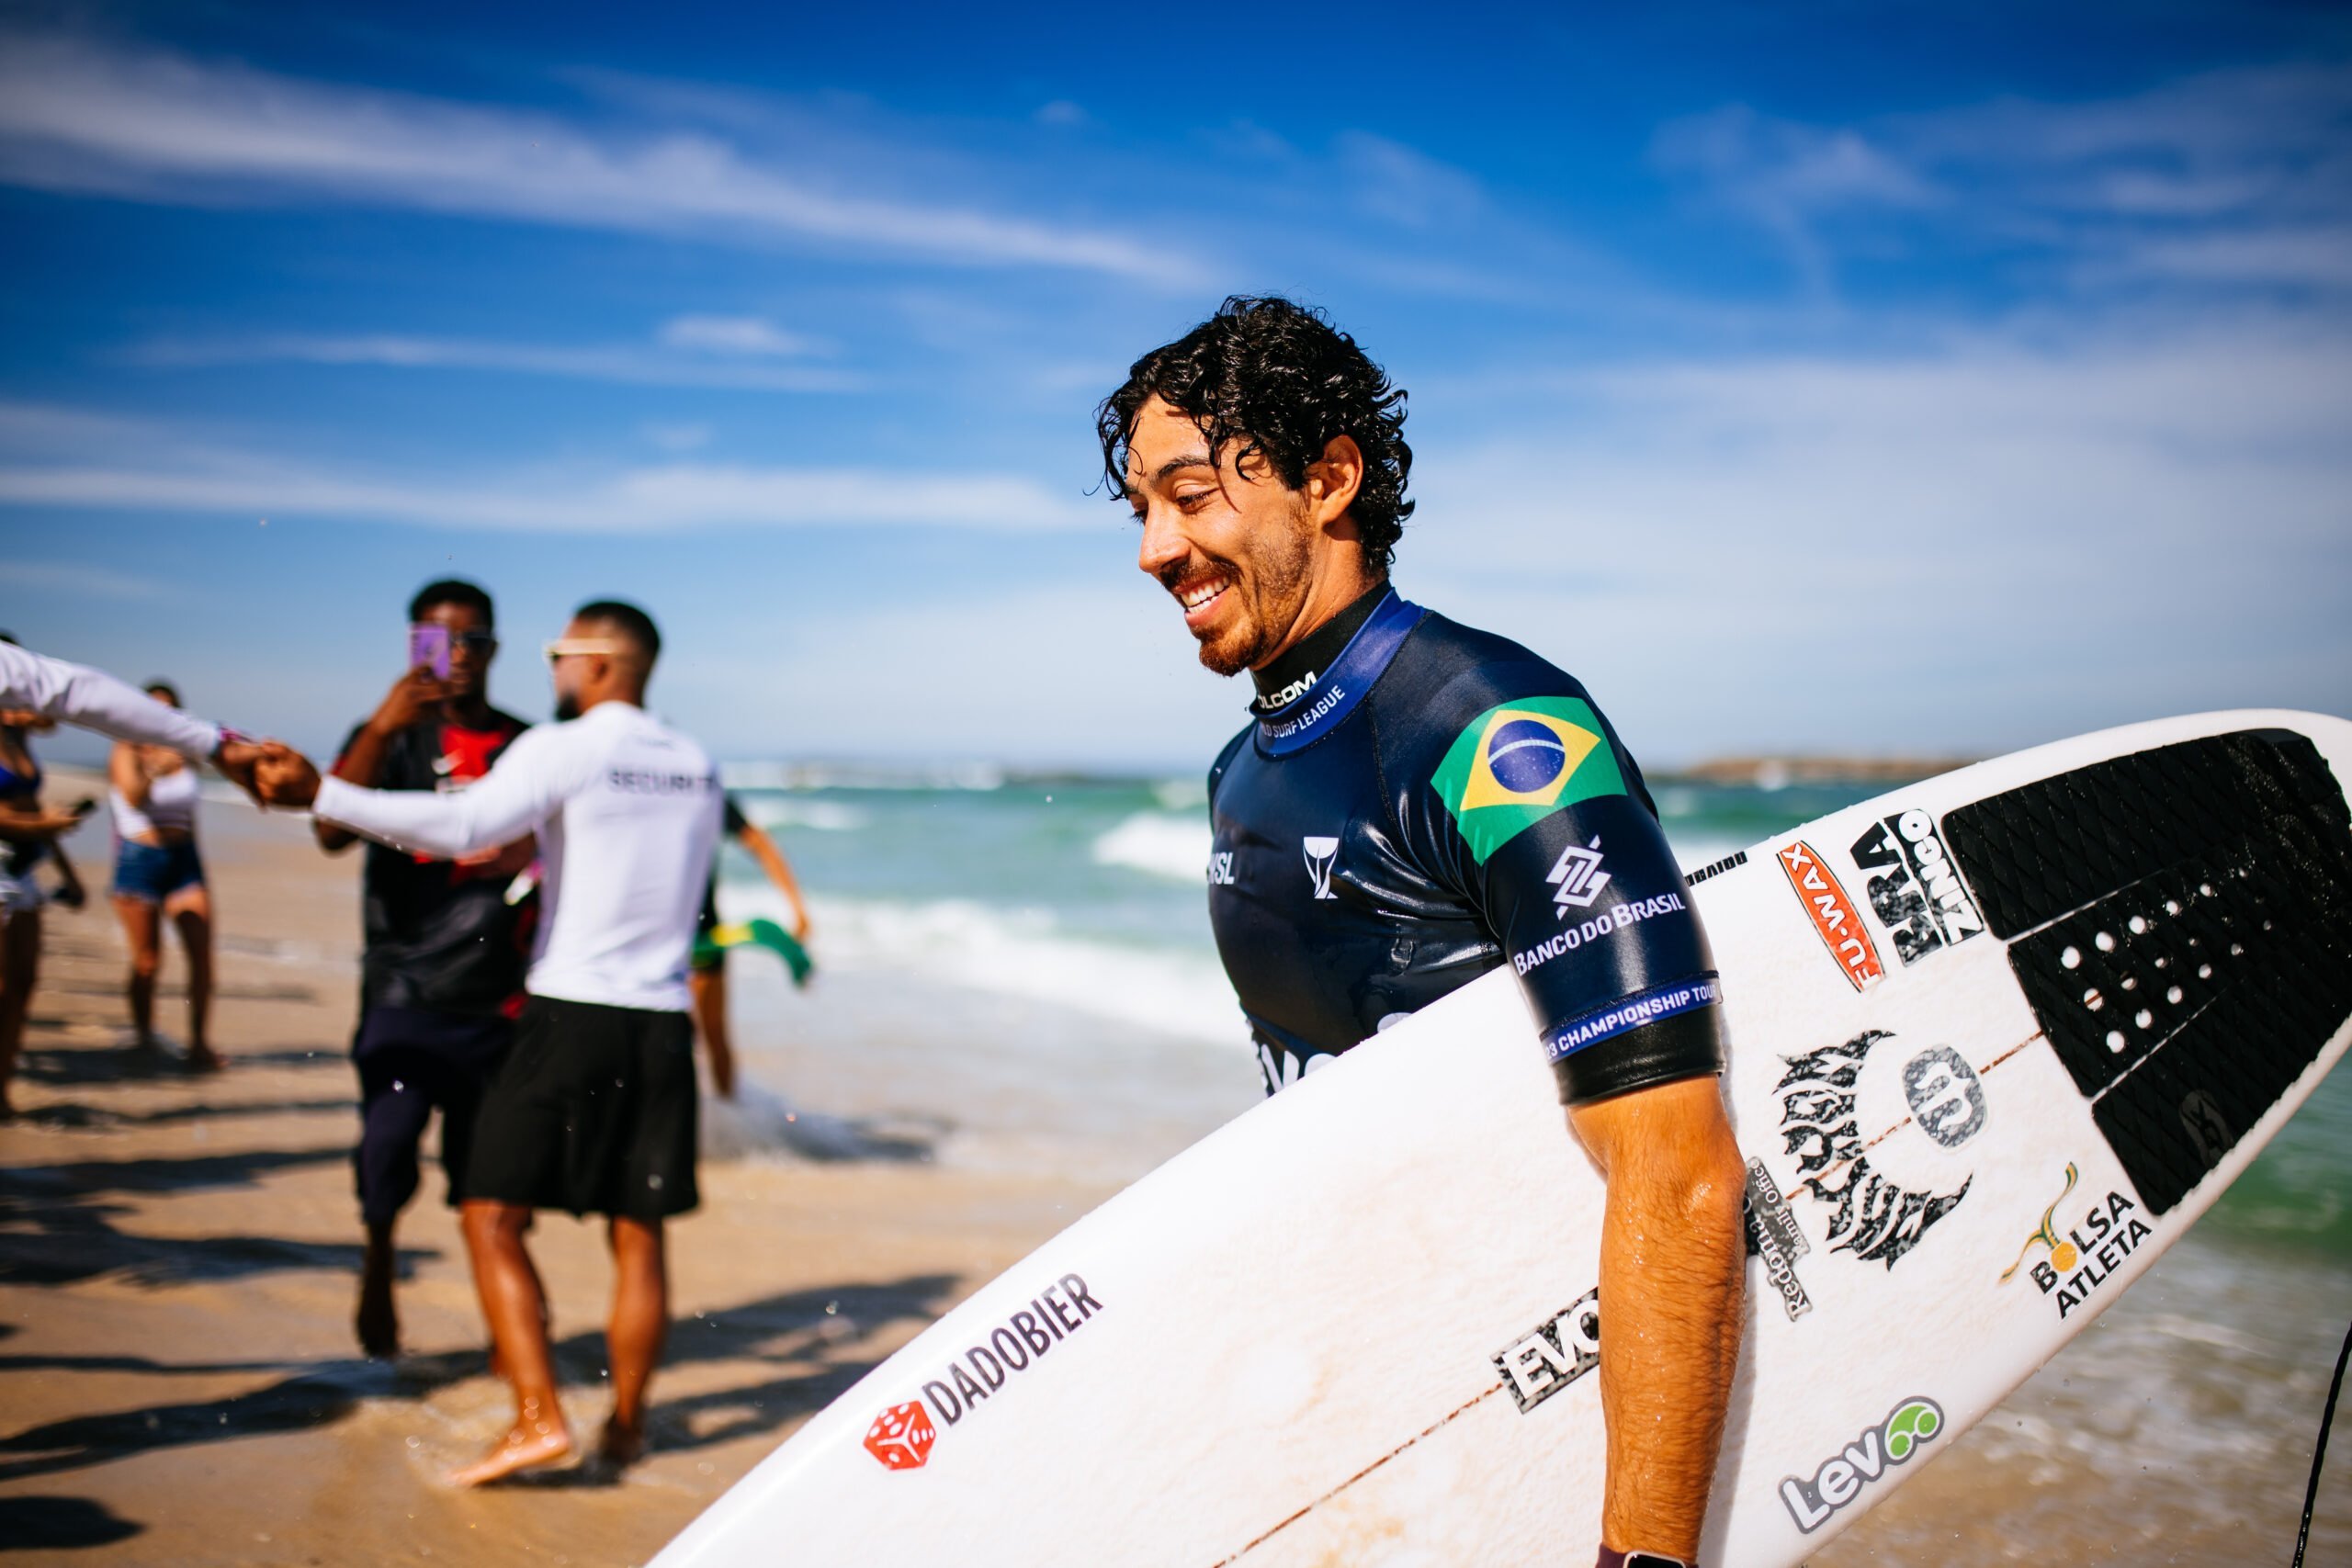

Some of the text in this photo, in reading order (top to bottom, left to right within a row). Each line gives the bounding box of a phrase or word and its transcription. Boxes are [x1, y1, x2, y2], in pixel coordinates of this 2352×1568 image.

[1272, 720, 1297, 738] SURF
[1297, 685, 1345, 730] LEAGUE
[1514, 893, 1685, 976] BANCO DO BRASIL
[1849, 821, 1946, 966] BRA
[1558, 992, 1690, 1051] CHAMPIONSHIP
[1750, 1159, 1779, 1203] Office
[1749, 1214, 1807, 1317] Redoma
[2055, 1218, 2153, 1319] ATLETA
[922, 1273, 1103, 1427] DADOBIER
